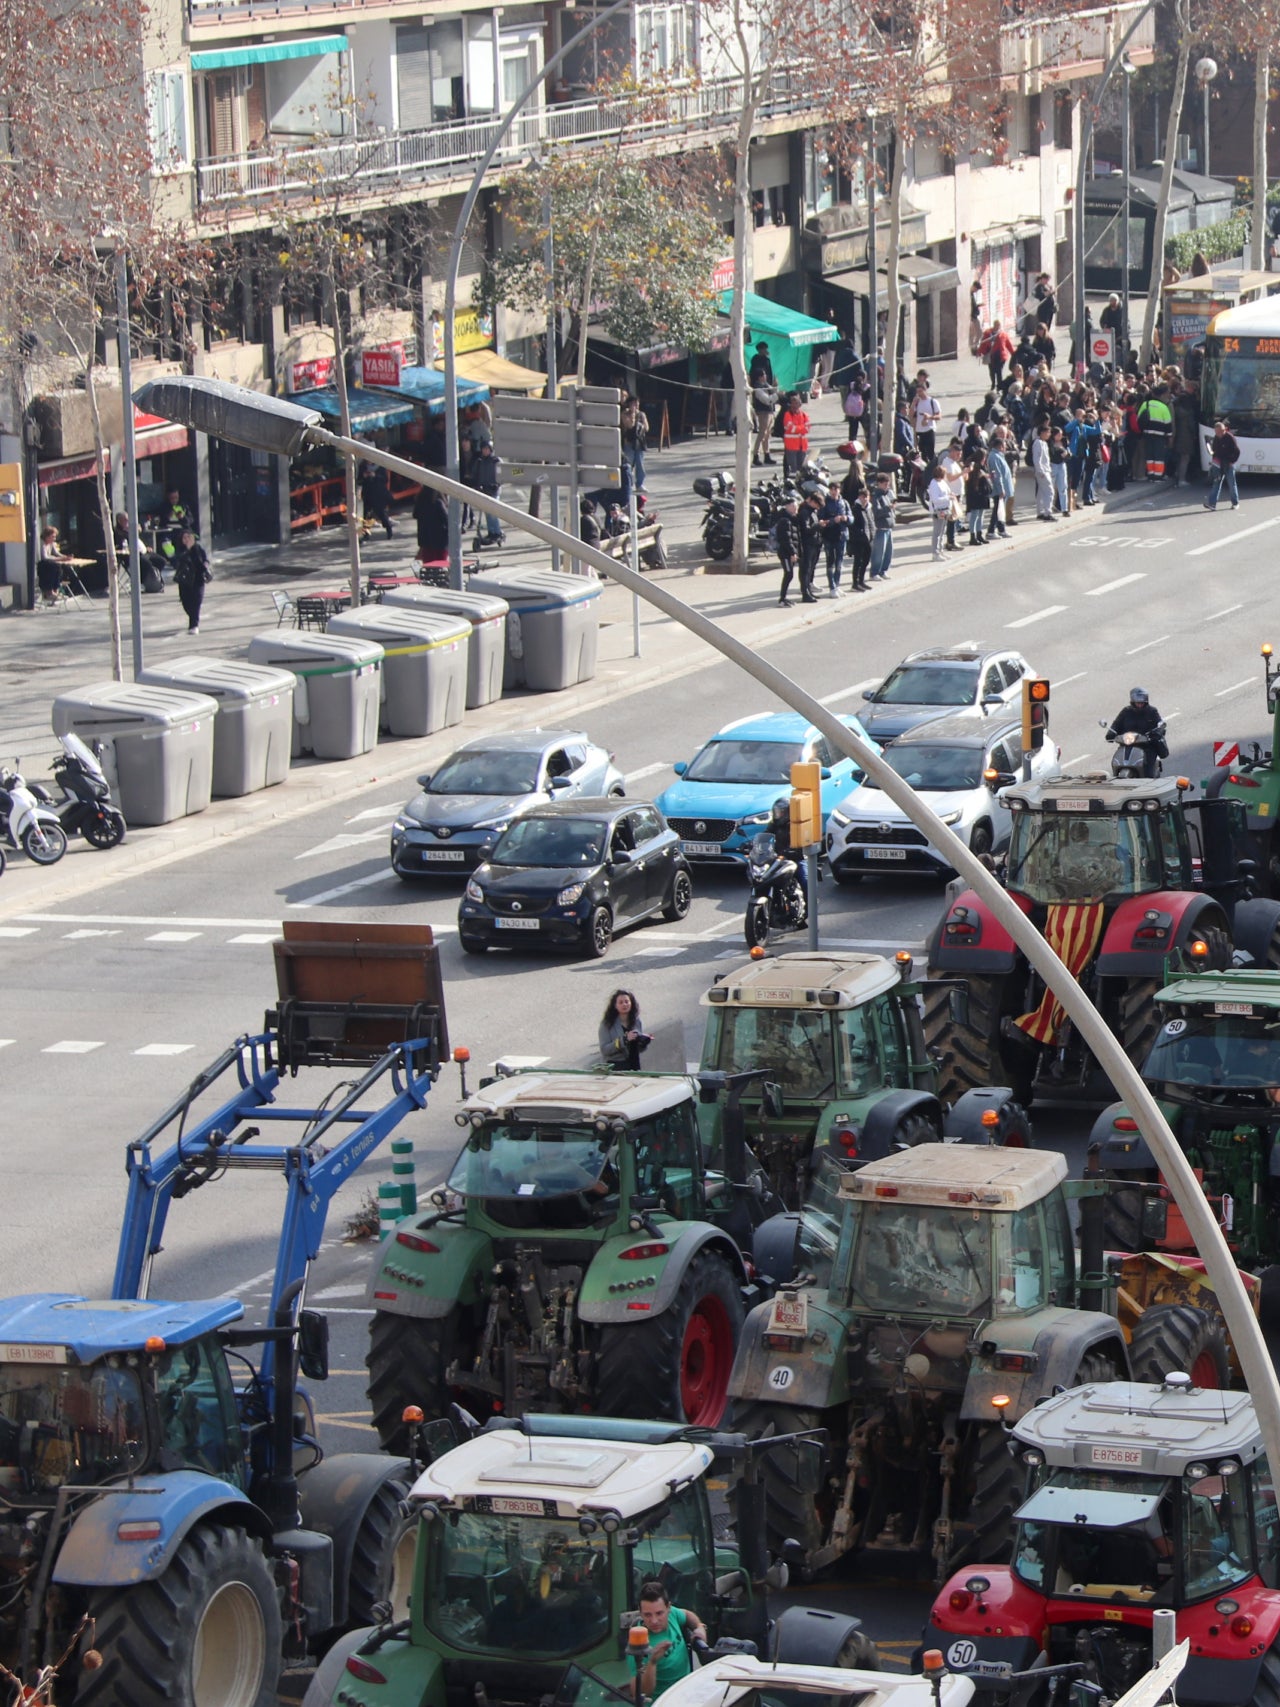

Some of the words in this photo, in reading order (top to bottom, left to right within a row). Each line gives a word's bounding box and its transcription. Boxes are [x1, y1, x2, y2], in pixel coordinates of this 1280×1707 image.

[1224, 337, 1240, 352] E4
[365, 358, 396, 373] YASIN
[1069, 536, 1176, 549] BUS
[501, 919, 520, 927] 9430
[522, 919, 537, 928] KLV
[1168, 1021, 1183, 1032] 50
[772, 1370, 789, 1386] 40
[1124, 1451, 1141, 1462] BGF
[502, 1500, 526, 1512] 7863
[526, 1503, 542, 1514] BGL
[952, 1643, 973, 1664] 50
